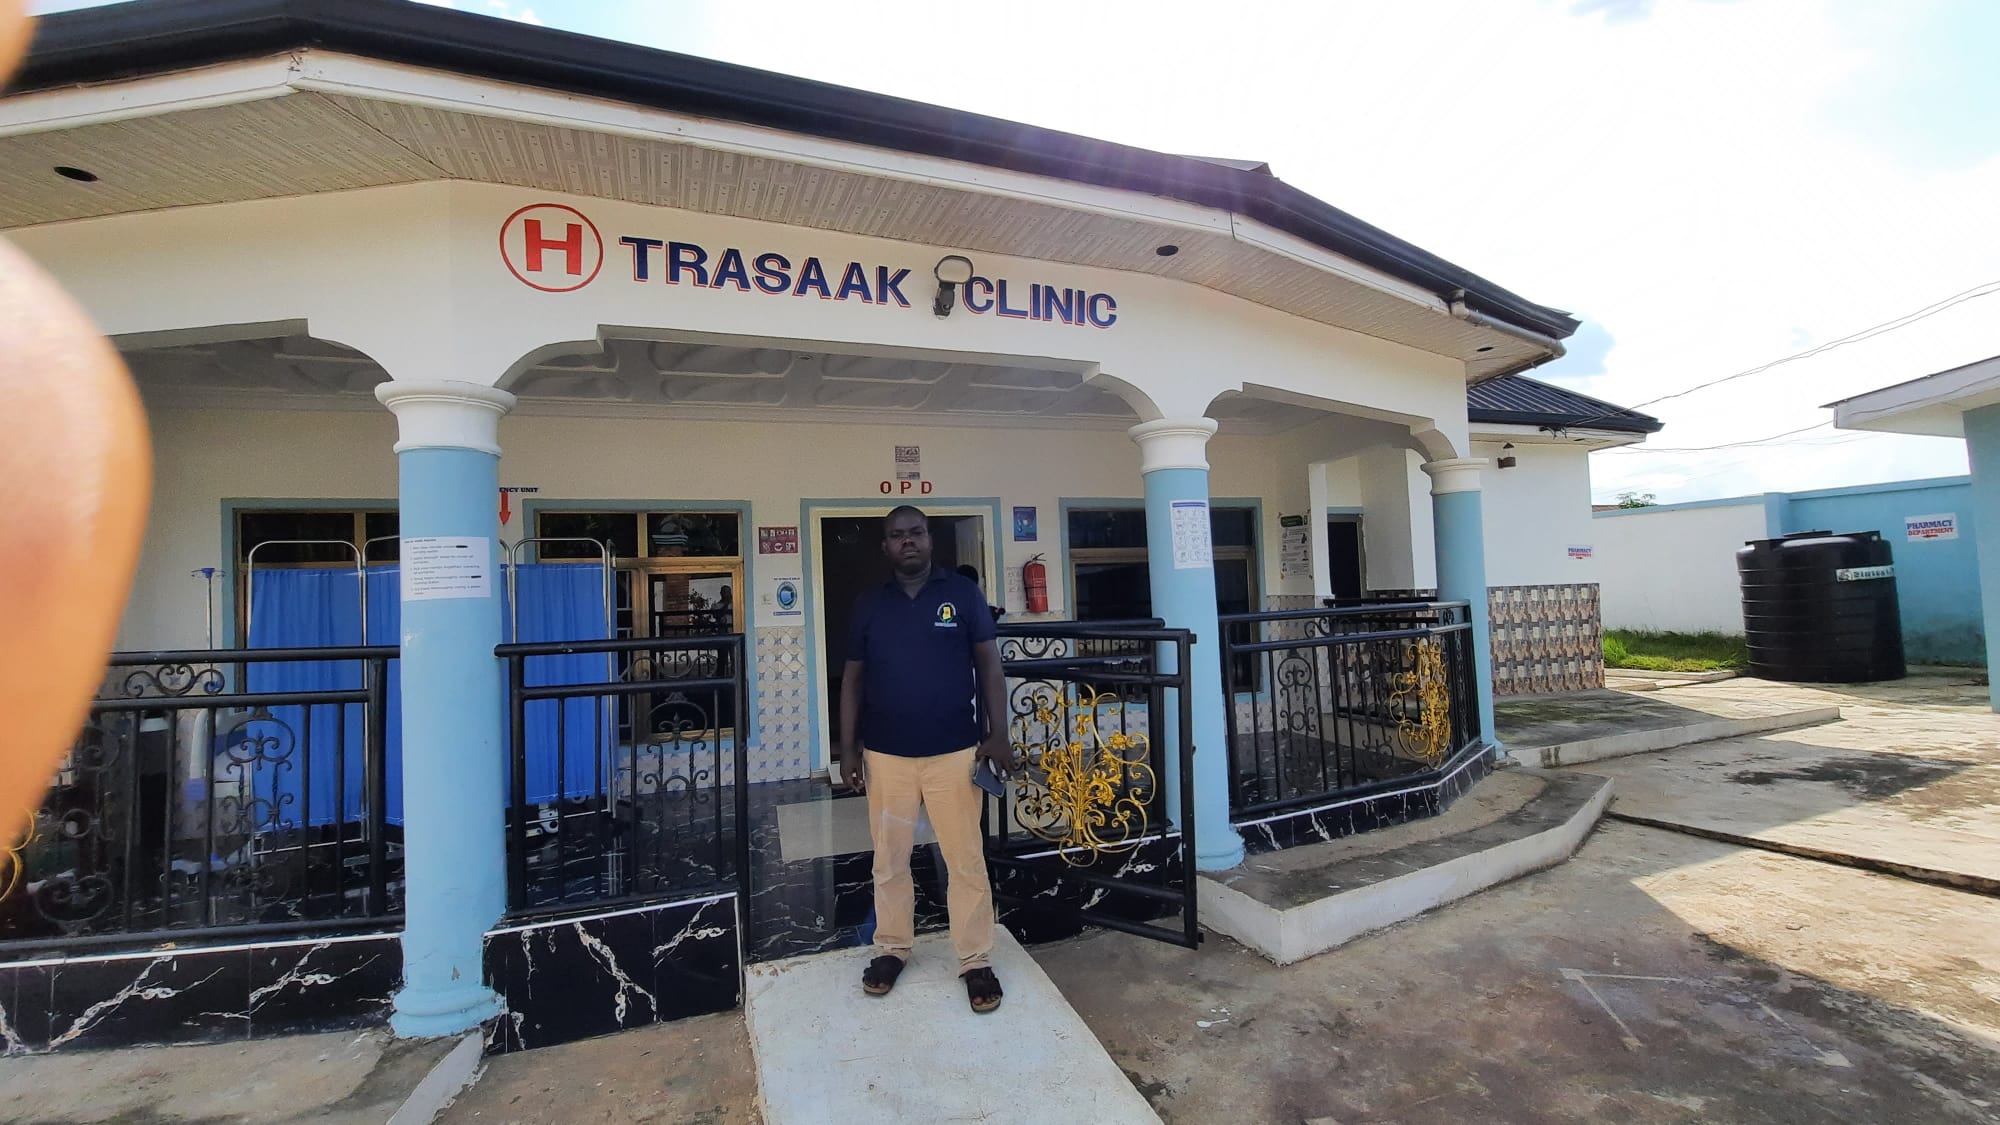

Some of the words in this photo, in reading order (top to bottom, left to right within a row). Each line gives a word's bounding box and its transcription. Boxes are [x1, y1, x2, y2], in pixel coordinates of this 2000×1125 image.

[524, 219, 582, 275] H
[619, 236, 912, 308] TRASAAK
[962, 276, 1118, 329] CLINIC
[1906, 519, 1953, 529] PHARMACY
[1908, 527, 1953, 536] DEPARTMENT
